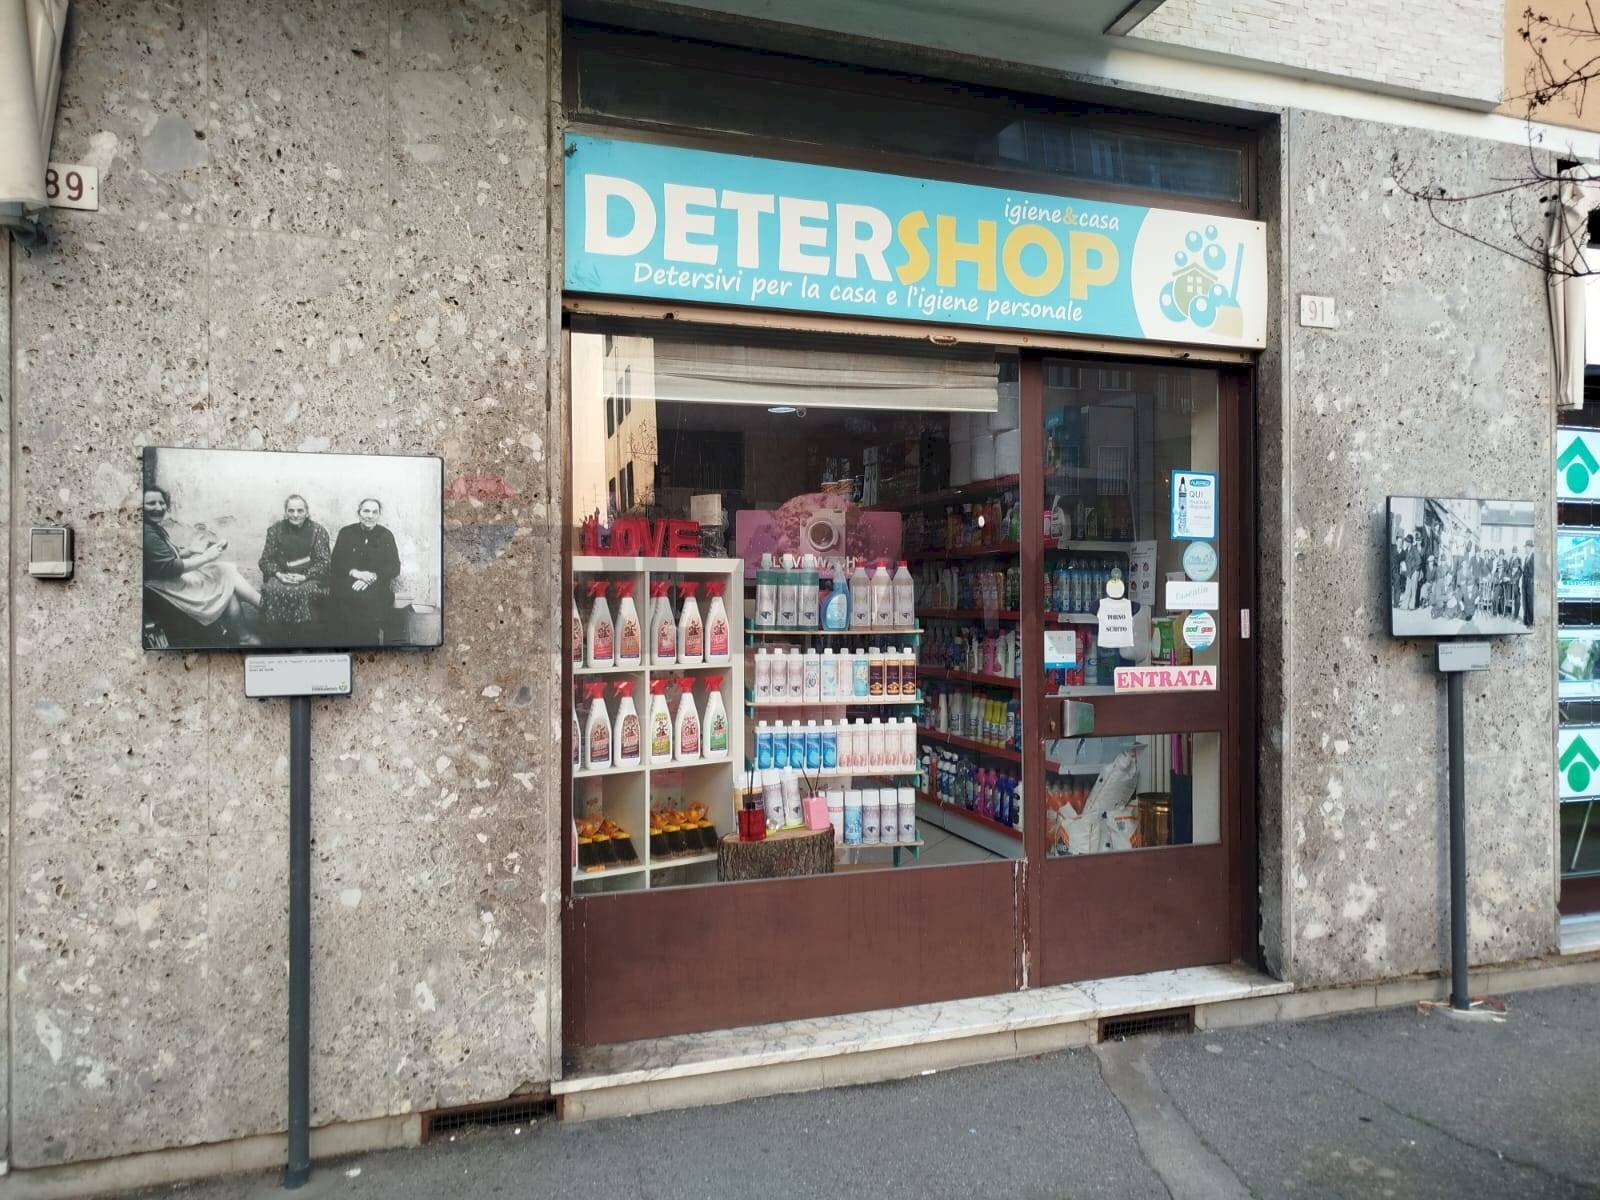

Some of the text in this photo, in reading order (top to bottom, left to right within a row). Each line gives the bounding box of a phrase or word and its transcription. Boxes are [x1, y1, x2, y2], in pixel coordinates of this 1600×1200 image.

[45, 168, 83, 202] 89
[584, 174, 1120, 300] DETERSHOP
[633, 261, 1083, 322] Detersivi per la casa e l'igiene personale
[1308, 300, 1325, 323] 91
[583, 515, 699, 557] LOVE
[1116, 669, 1213, 689] ENTRATA
